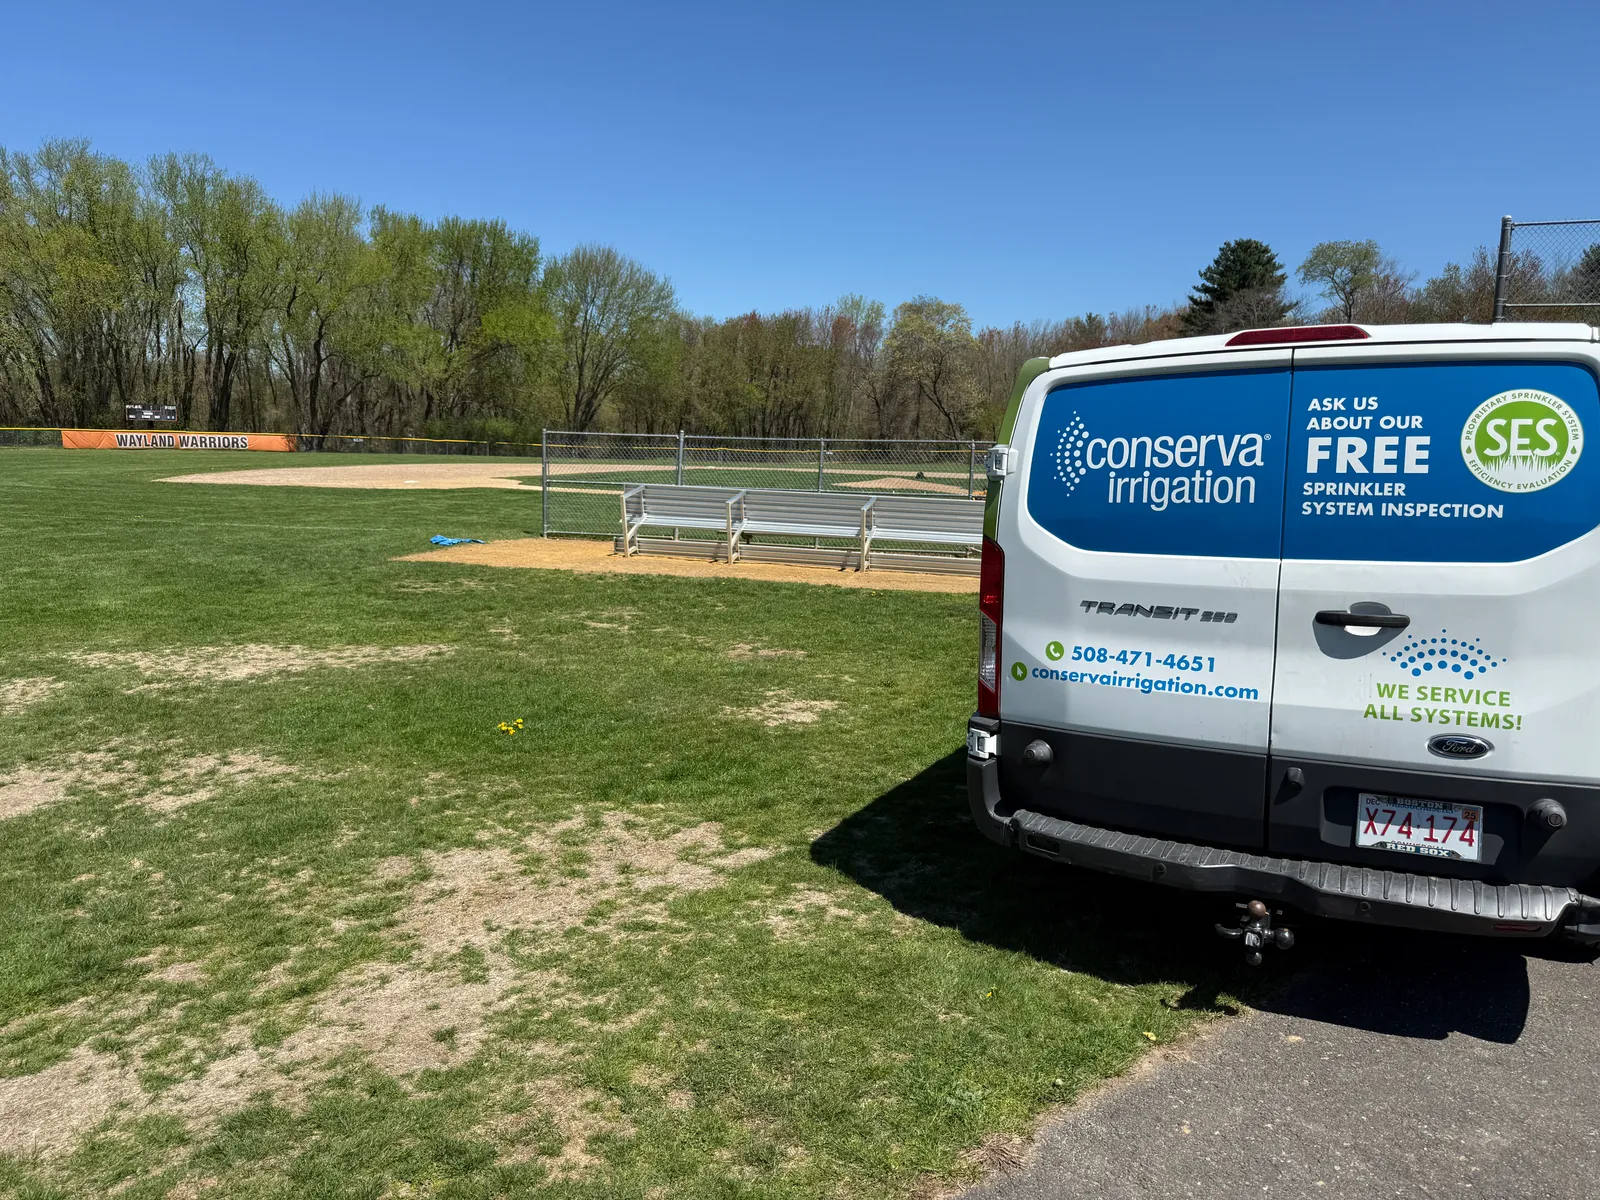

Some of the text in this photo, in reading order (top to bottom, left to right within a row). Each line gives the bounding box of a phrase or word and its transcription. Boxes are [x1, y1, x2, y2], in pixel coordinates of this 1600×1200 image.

[1308, 397, 1378, 411] ASK US
[1306, 416, 1423, 430] ABOUT OUR
[1465, 392, 1579, 440] PROPRIETARY SPRINKLER SYSTEM
[115, 434, 248, 449] WAYLAND WARRIORS
[1483, 418, 1558, 457] SES
[1306, 436, 1431, 474] FREE
[1468, 459, 1573, 490] EFFICIENCY EVALUATION
[1108, 470, 1256, 511] irrigation
[1302, 482, 1406, 496] SPRINKLER
[1301, 502, 1504, 519] SYSTEM INSPECTION
[1079, 600, 1199, 621] TRANSIT
[1071, 646, 1215, 673] 508-471-4651
[1031, 666, 1259, 700] conservairrigation.com
[1376, 683, 1511, 707] WE SERVICE
[1363, 703, 1522, 731] ALL SYSTEMS!
[1442, 740, 1476, 754] Ford
[1396, 799, 1443, 809] BOSTON
[1464, 811, 1476, 820] 25
[1386, 843, 1416, 853] RED
[1419, 847, 1450, 857] SOX
